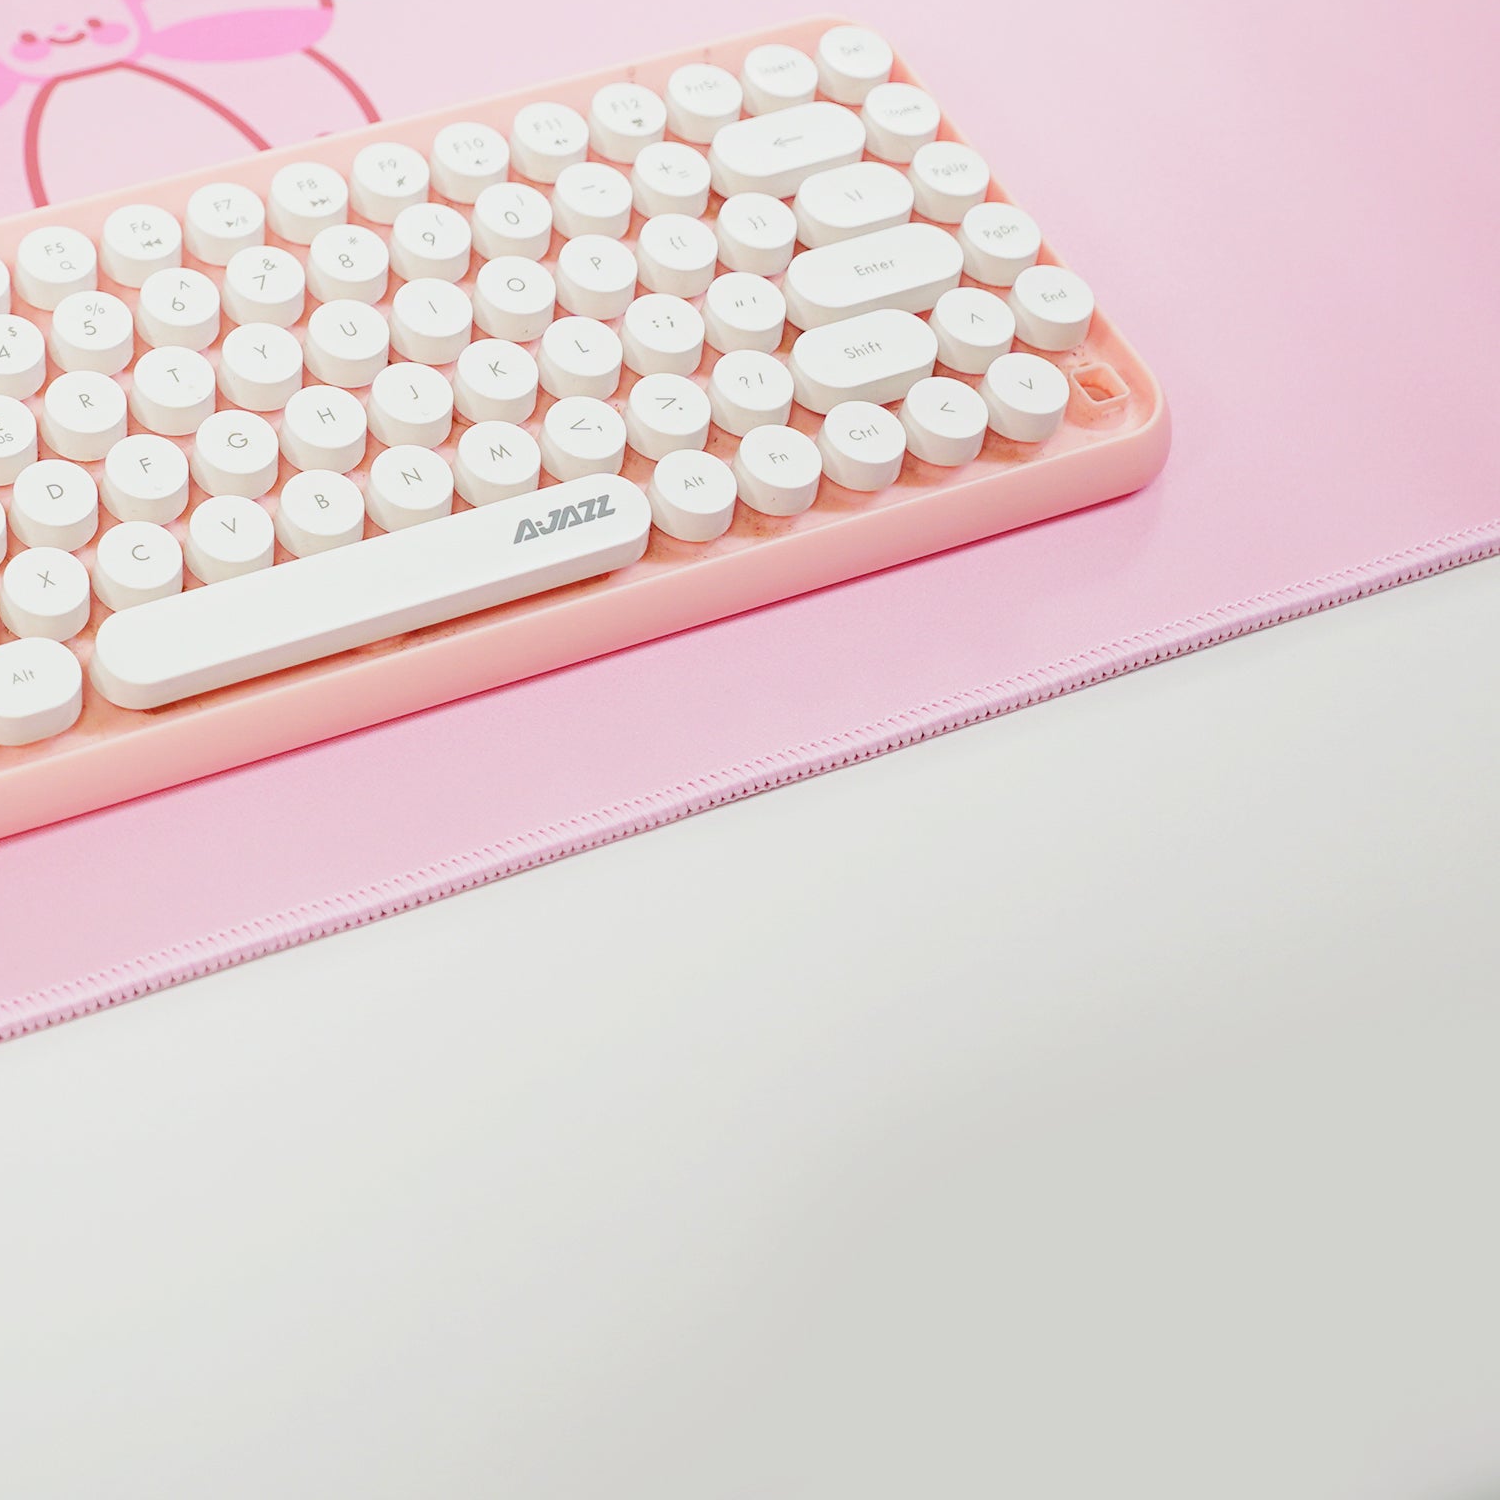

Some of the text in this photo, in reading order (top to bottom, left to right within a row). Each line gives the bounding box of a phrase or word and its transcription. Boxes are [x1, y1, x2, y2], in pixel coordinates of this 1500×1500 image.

[609, 97, 642, 114] F12
[532, 117, 563, 134] F11
[452, 136, 485, 154] F10
[377, 158, 398, 172] F9
[930, 162, 969, 177] PgUp
[296, 178, 319, 192] F8
[212, 197, 232, 213] F7
[129, 220, 152, 234] F6
[982, 224, 1020, 240] PgDn
[421, 231, 436, 247] 9
[43, 241, 66, 257] F5
[261, 258, 278, 271] &
[337, 253, 355, 269] 8
[589, 256, 602, 271] P
[853, 259, 895, 277] Enter
[252, 273, 267, 292] 7
[506, 277, 527, 293] O
[171, 296, 186, 312] 6
[1040, 288, 1068, 304] End
[84, 301, 107, 317] %
[7, 326, 18, 338] $
[82, 319, 98, 337] 5
[339, 321, 358, 338] U
[253, 344, 268, 360] Y
[573, 339, 590, 354] L
[843, 341, 883, 360] Shift
[166, 367, 180, 384] T
[487, 360, 508, 378] K
[409, 384, 420, 401] J
[78, 393, 95, 409] R
[316, 406, 337, 425] H
[228, 432, 249, 449] G
[848, 424, 880, 442] Ctrl
[489, 443, 513, 462] M
[767, 452, 790, 465] Fn
[138, 456, 152, 474] F
[400, 467, 423, 486] N
[683, 475, 706, 491] Alt
[45, 483, 65, 501] D
[313, 493, 331, 510] B
[220, 517, 237, 535] V
[130, 543, 151, 562] C
[36, 570, 56, 589] X
[12, 669, 35, 685] Alt
